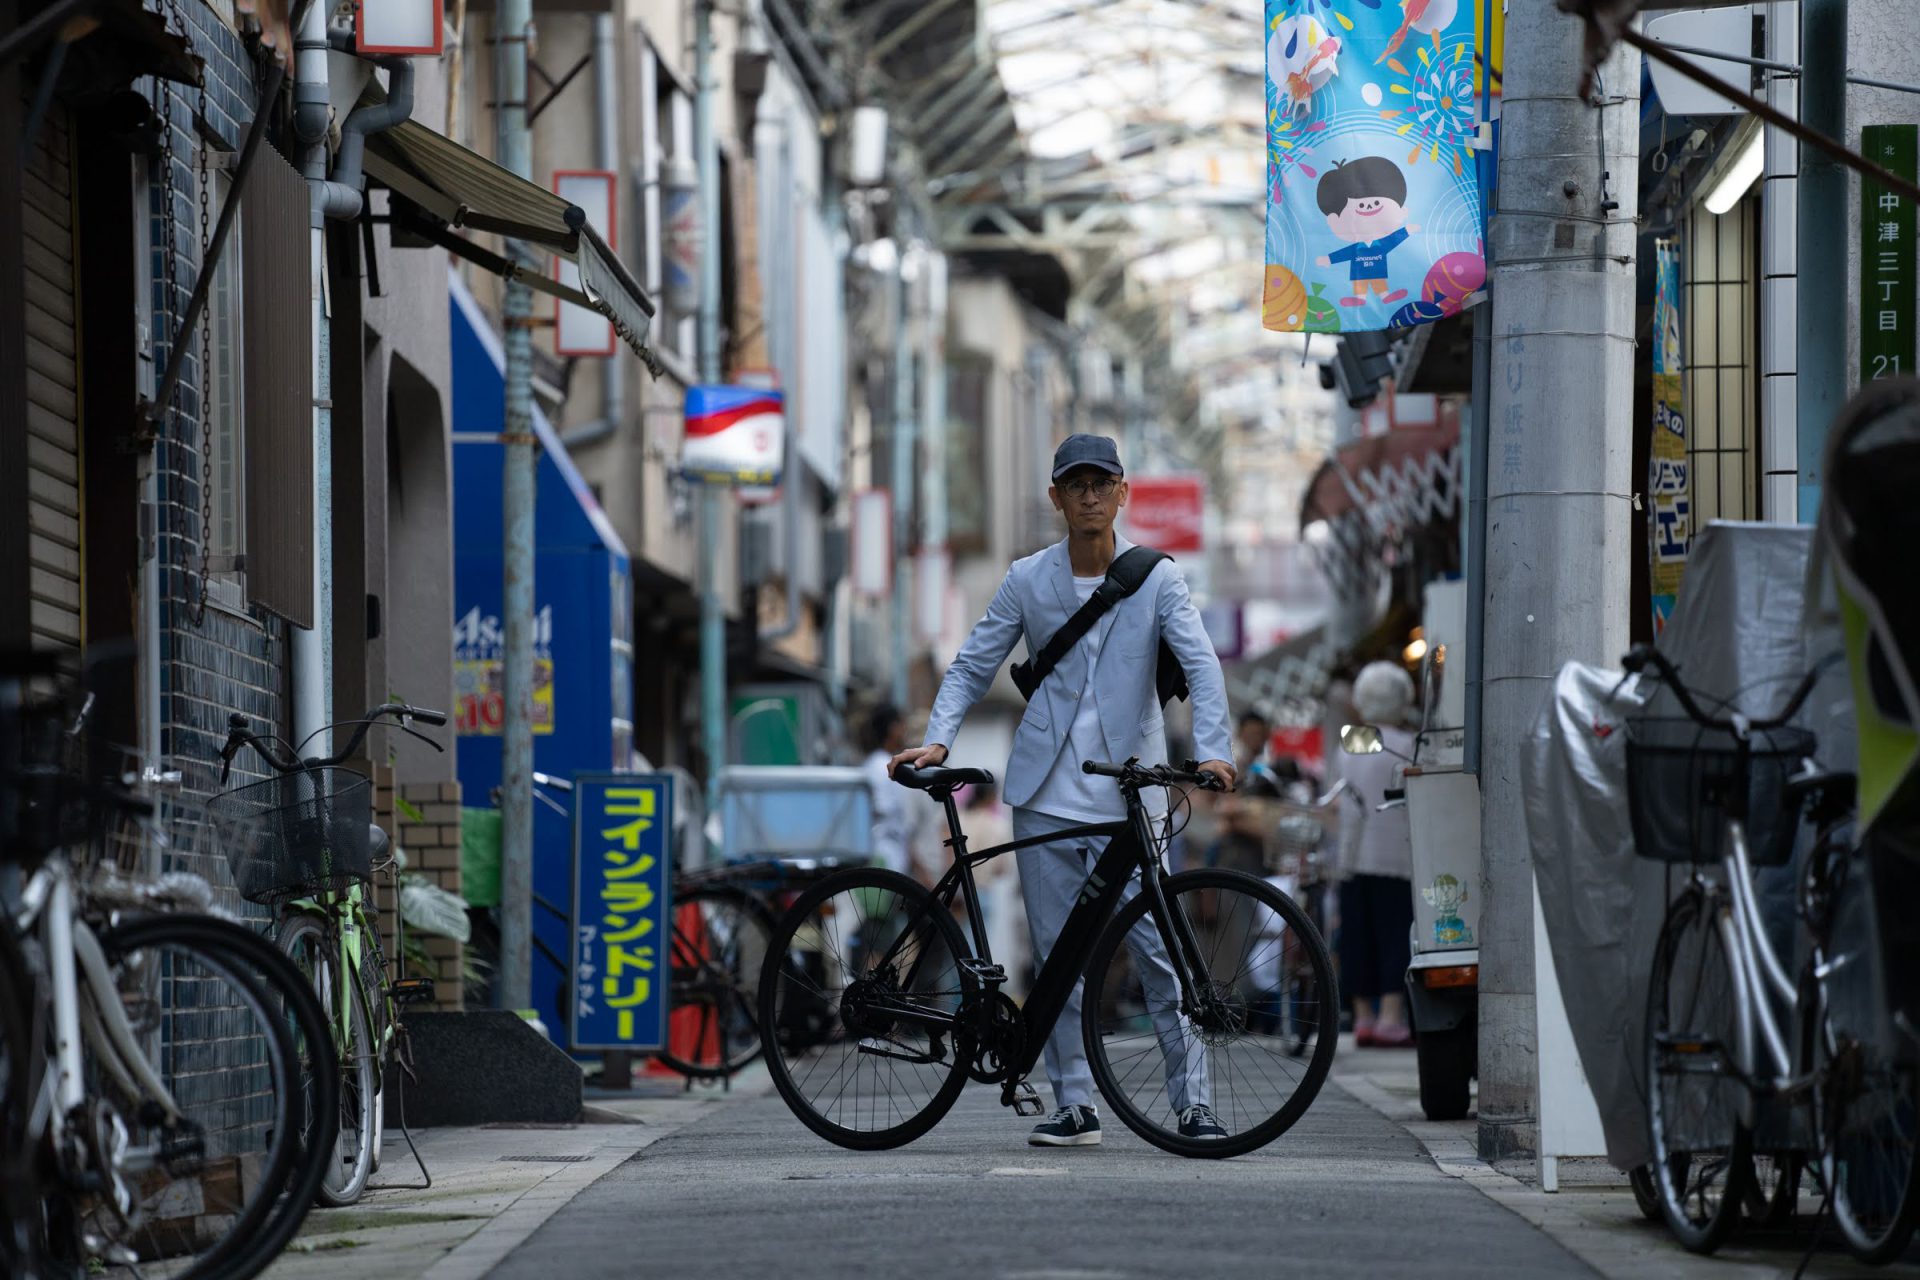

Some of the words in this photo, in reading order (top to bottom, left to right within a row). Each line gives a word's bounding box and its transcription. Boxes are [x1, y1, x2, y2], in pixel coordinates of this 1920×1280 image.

[1877, 191, 1900, 331] 中津三丁目
[1502, 323, 1526, 514] はり紙禁止
[1871, 354, 1901, 381] 21
[601, 787, 656, 1040] コインランドリー
